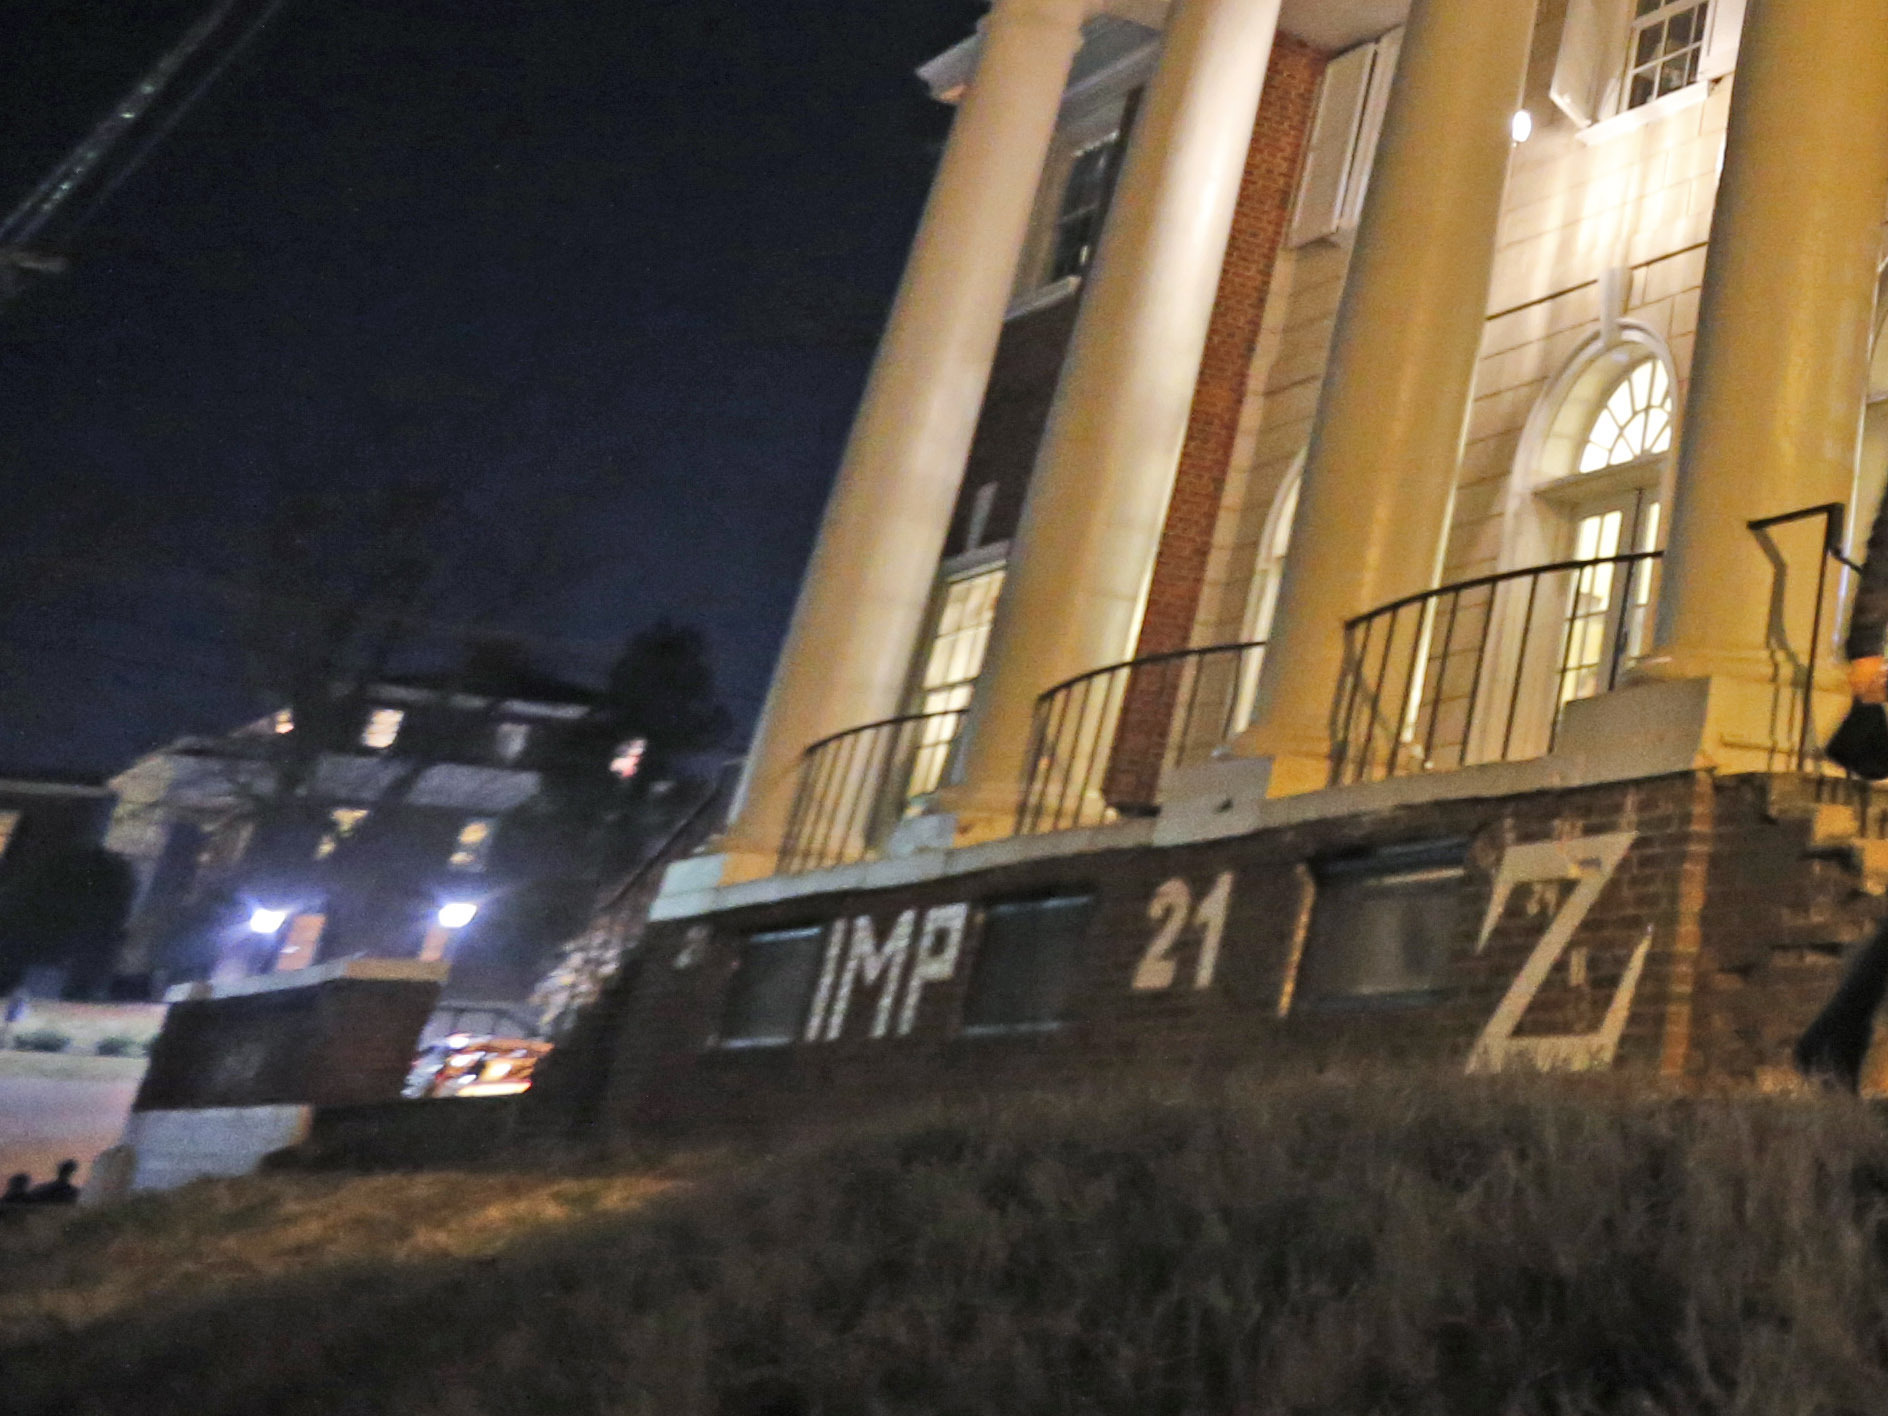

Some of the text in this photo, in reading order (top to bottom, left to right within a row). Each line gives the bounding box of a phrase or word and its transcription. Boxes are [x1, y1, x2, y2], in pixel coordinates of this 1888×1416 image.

[807, 902, 968, 1042] IMP
[1131, 871, 1234, 990] 21
[1465, 831, 1654, 1074] Z
